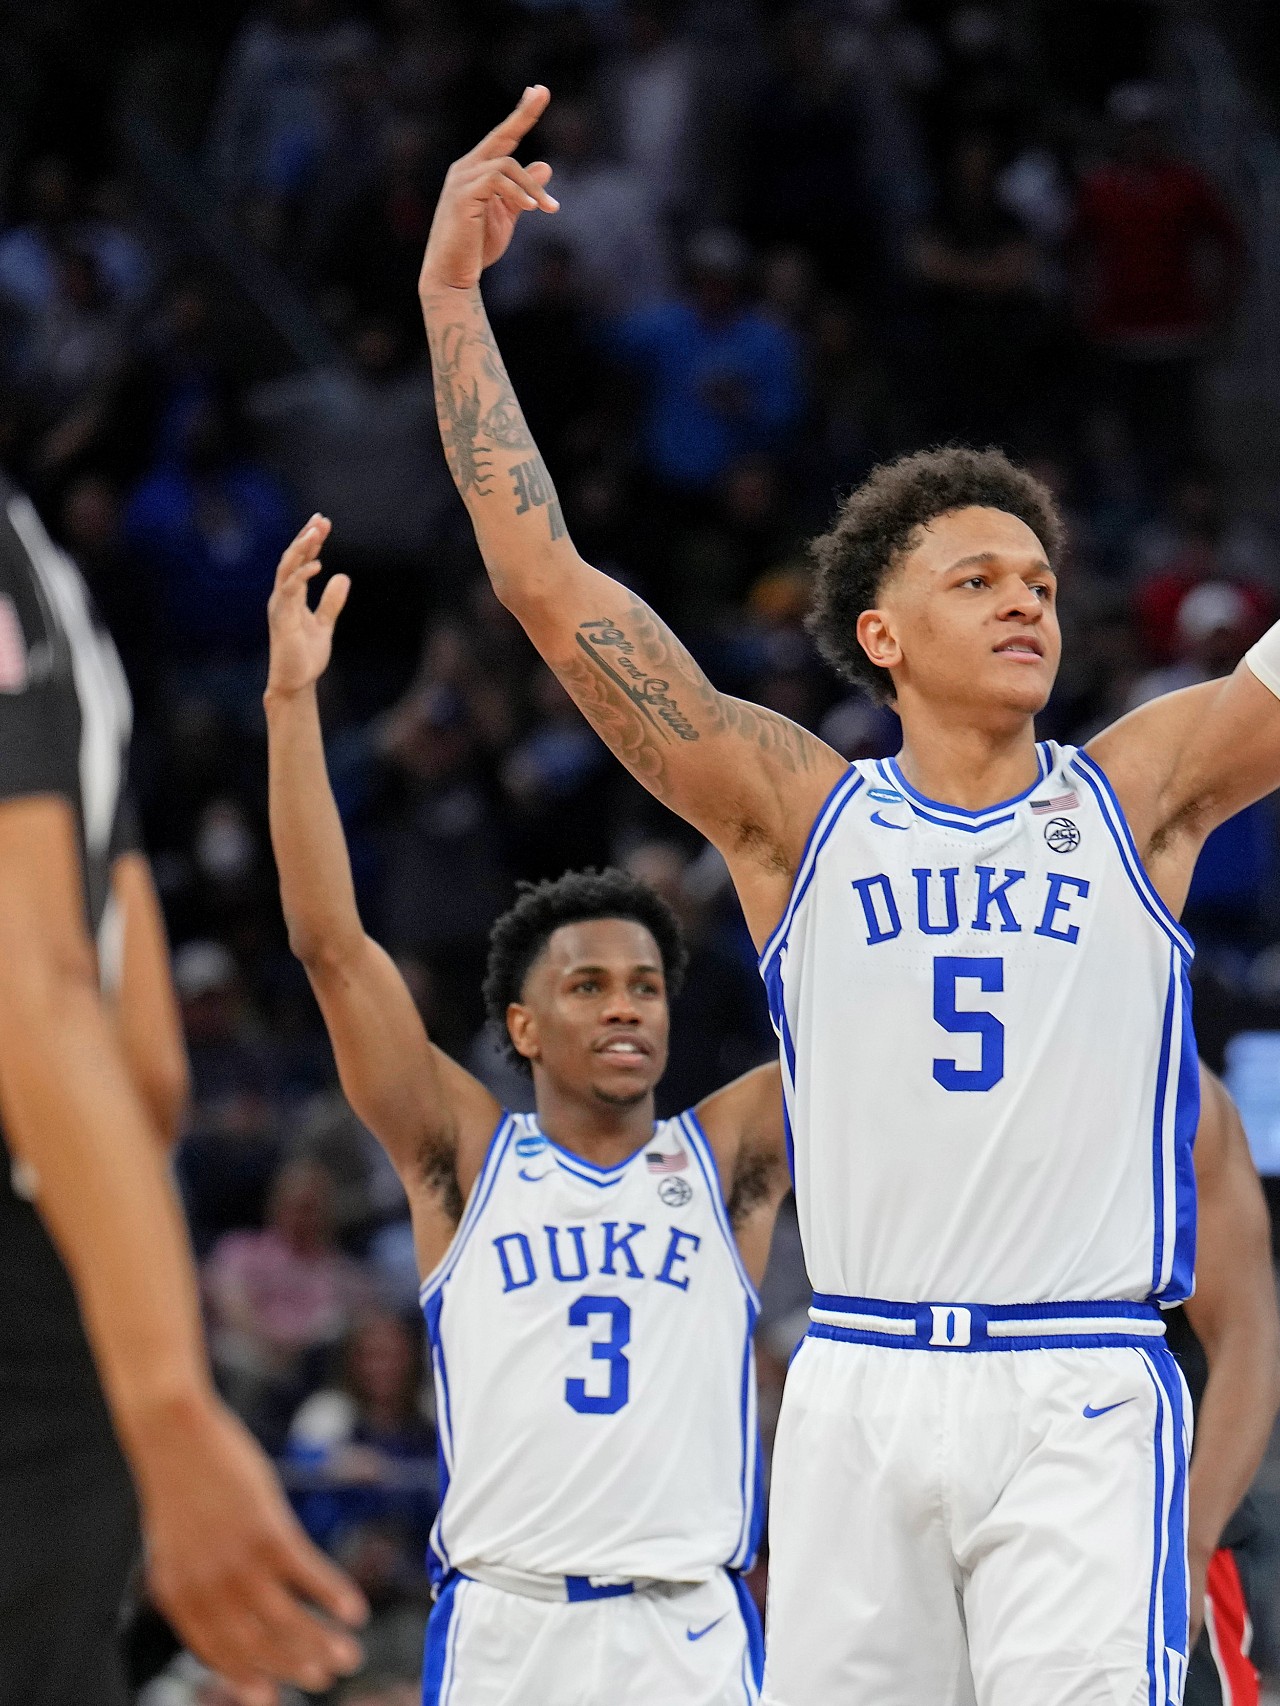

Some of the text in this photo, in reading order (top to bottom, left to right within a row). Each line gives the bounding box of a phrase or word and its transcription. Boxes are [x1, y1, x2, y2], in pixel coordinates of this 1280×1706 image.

[852, 865, 1090, 946] DUKE
[932, 956, 1004, 1092] 5
[492, 1222, 701, 1294] DUKE
[565, 1295, 631, 1415] 3
[929, 1306, 972, 1347] D
